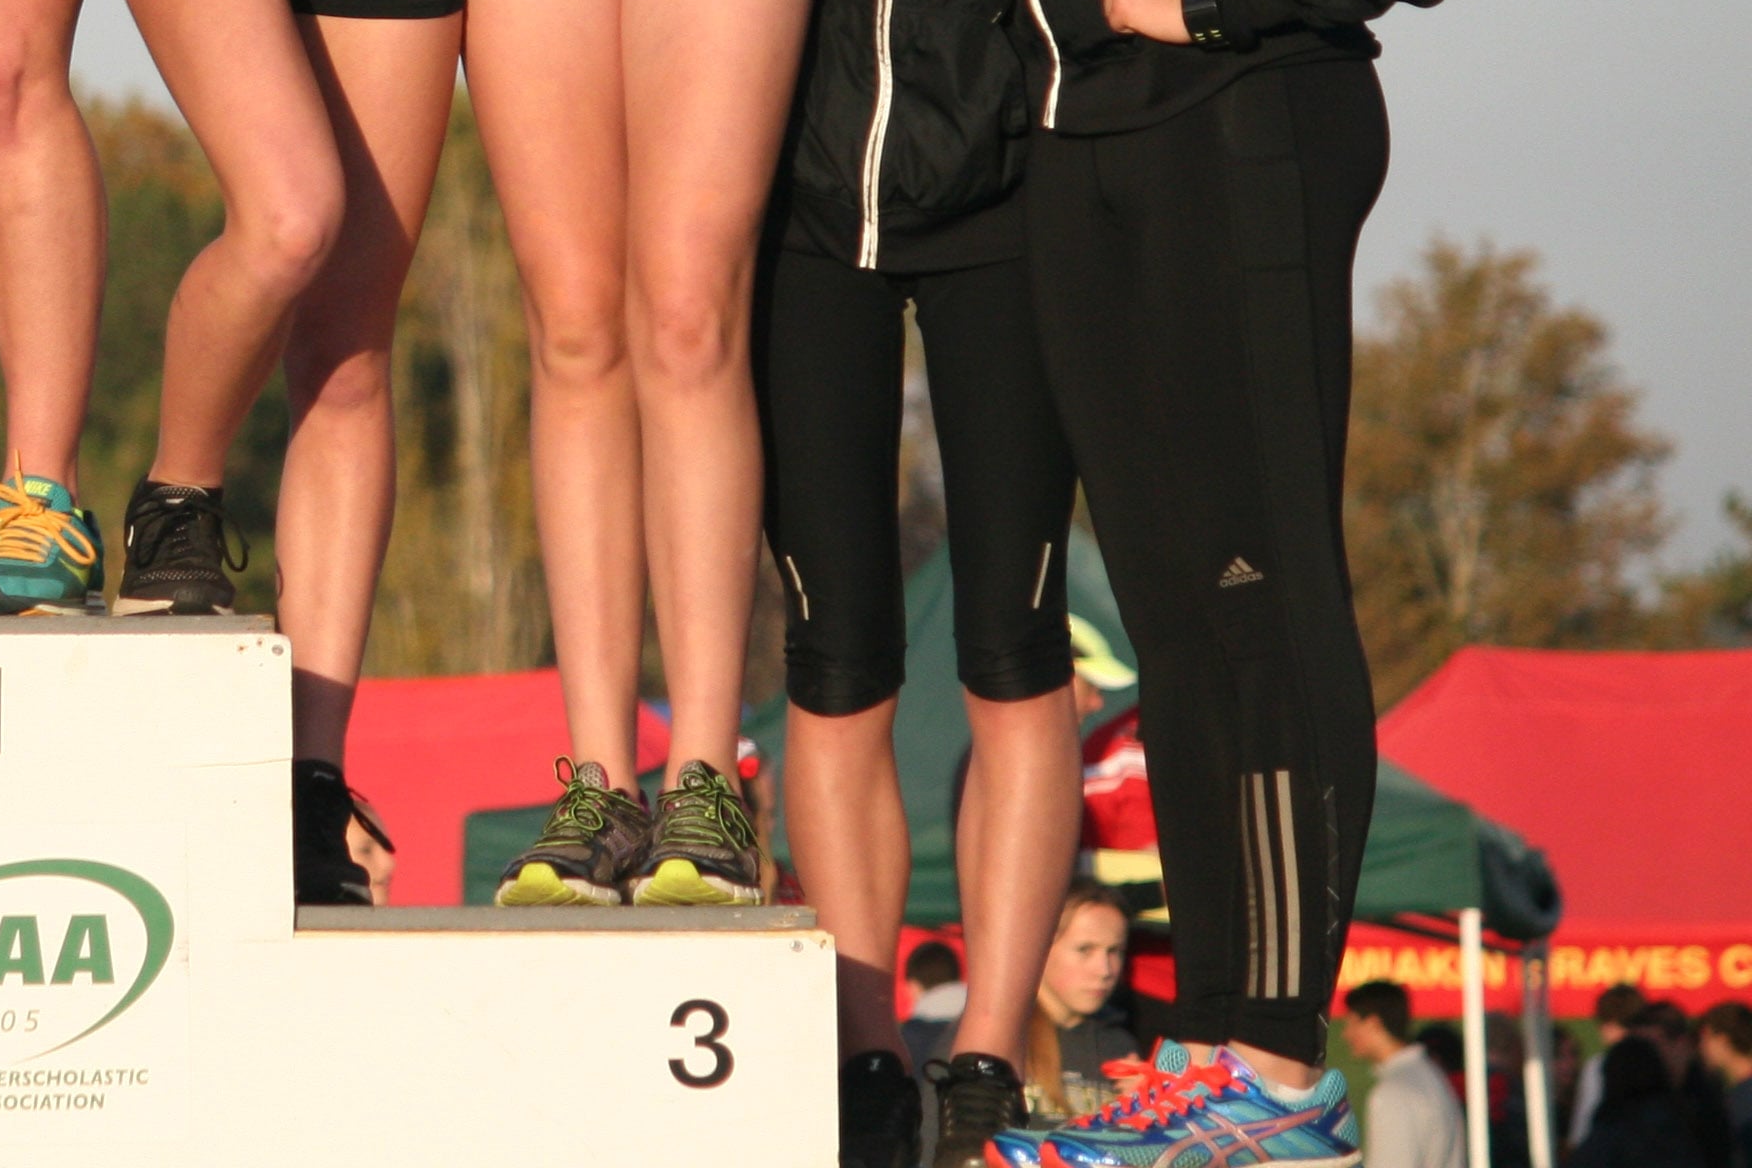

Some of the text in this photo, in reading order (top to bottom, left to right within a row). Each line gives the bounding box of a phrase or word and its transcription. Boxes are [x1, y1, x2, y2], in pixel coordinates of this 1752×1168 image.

[24, 480, 53, 496] NIKE
[1220, 572, 1264, 588] adidas
[667, 998, 736, 1090] 3
